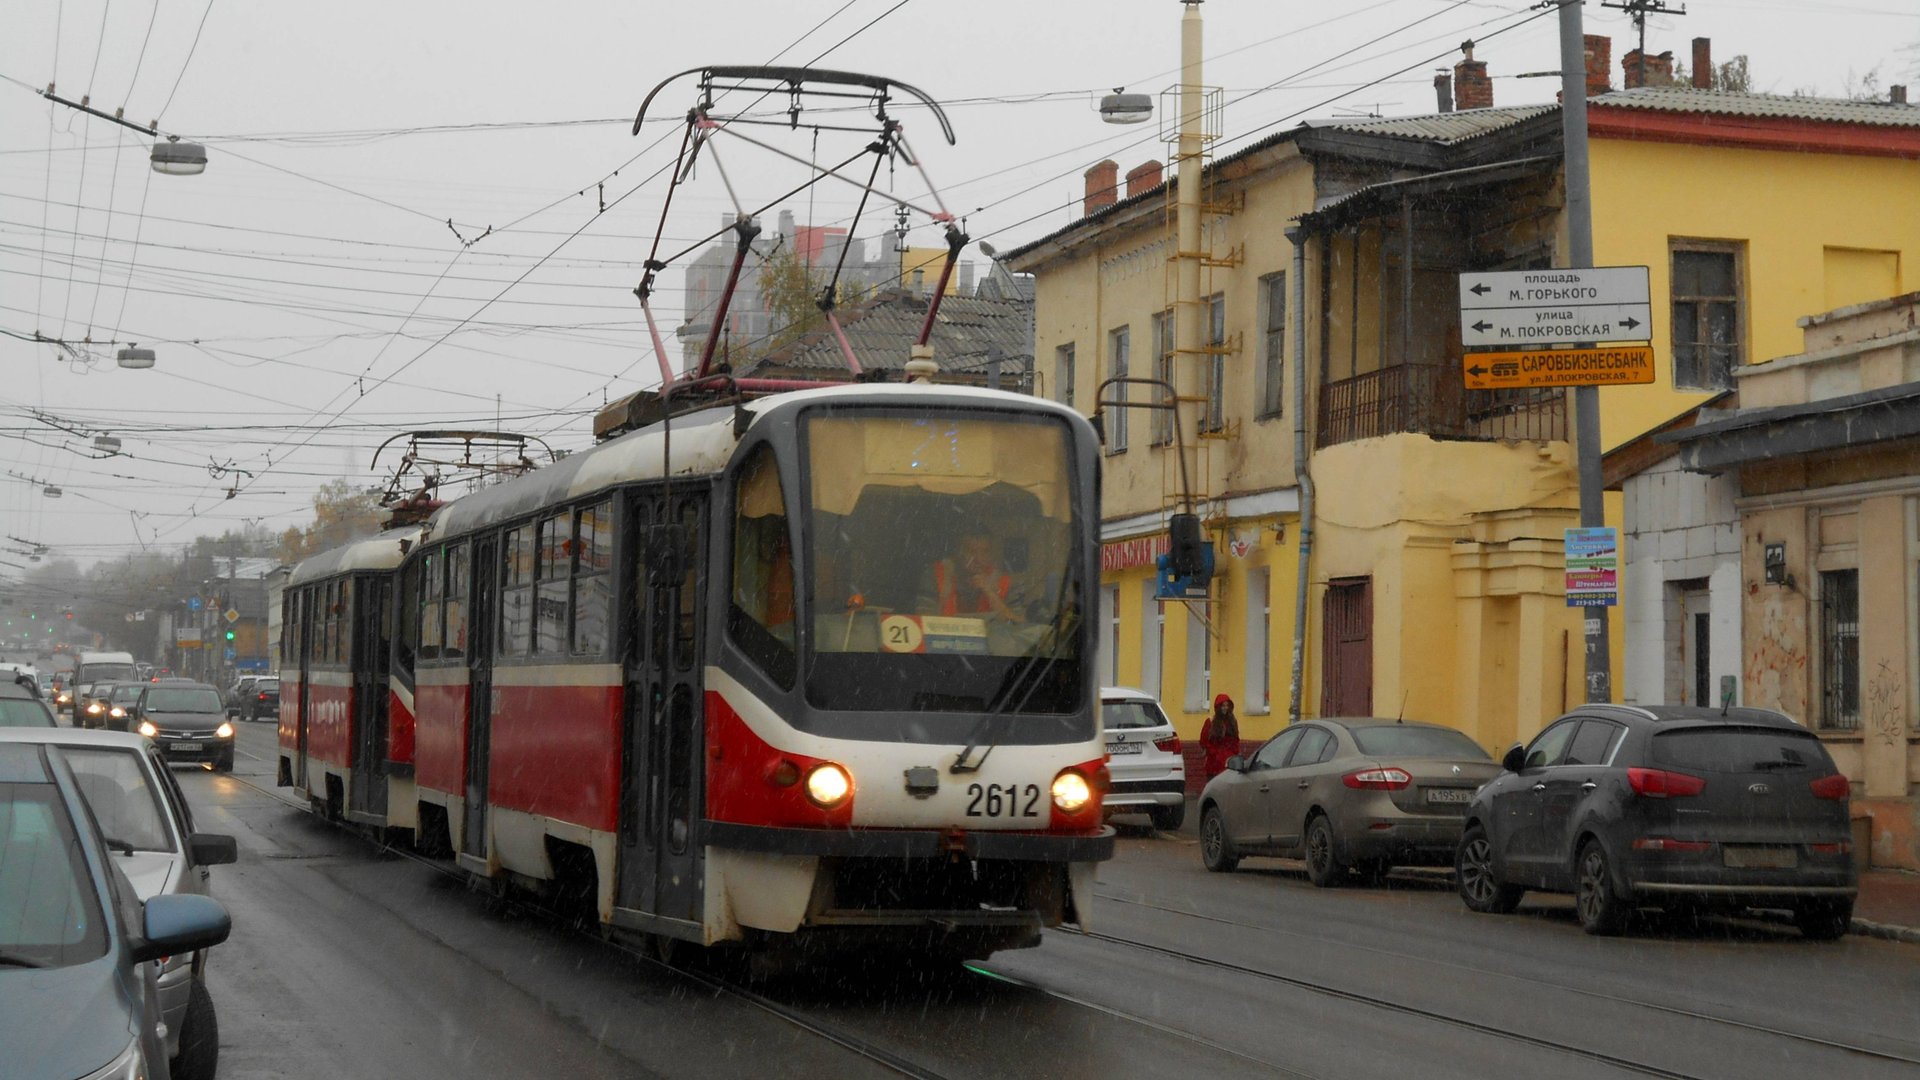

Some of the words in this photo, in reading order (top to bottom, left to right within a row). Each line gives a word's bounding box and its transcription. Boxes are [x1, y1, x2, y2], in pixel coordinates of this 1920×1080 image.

[1524, 274, 1581, 284] площадь
[1509, 290, 1524, 300] М.
[1527, 288, 1598, 300] ГОРЬКОГО
[1535, 311, 1574, 323] улица
[1500, 328, 1515, 338] М.
[1518, 324, 1611, 338] ПОКРОВСКАЯ
[1522, 352, 1647, 372] САРОВБИЗНЕСБАНК
[889, 625, 910, 643] 21
[966, 783, 1040, 818] 2612
